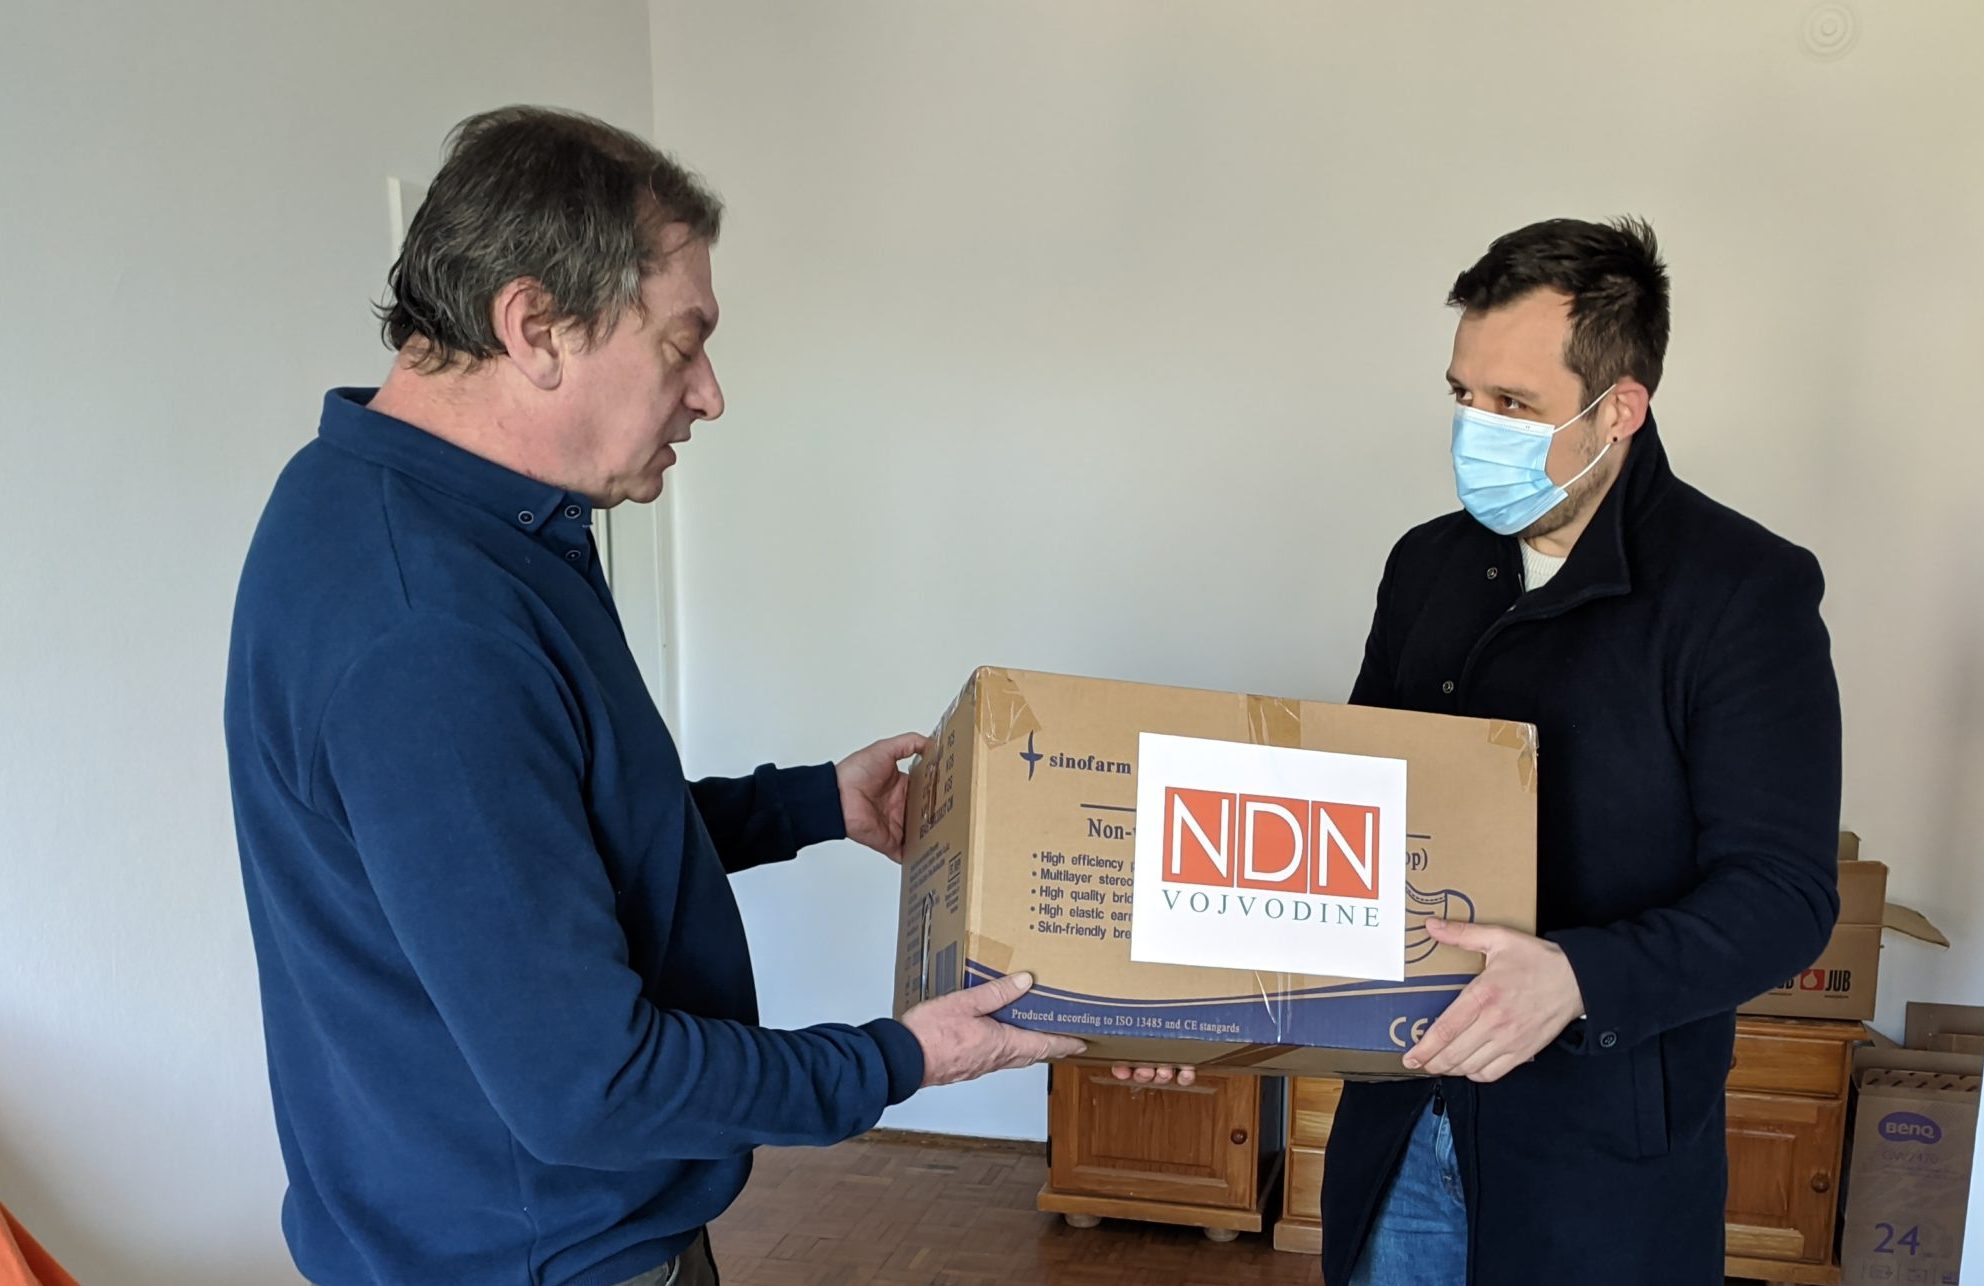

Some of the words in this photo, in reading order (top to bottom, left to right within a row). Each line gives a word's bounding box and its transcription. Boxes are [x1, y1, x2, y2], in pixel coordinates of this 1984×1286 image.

[1049, 753, 1132, 775] sinofarm
[1087, 818, 1136, 840] Non-
[1171, 793, 1374, 891] NDN
[1041, 851, 1065, 866] High
[1071, 854, 1124, 872] efficiency
[1040, 868, 1092, 885] Multilayer
[1040, 885, 1064, 901] High
[1070, 889, 1106, 904] quality
[1039, 903, 1063, 919] High
[1069, 906, 1104, 920] elastic
[1161, 889, 1380, 928] VOJVODINE
[1038, 921, 1106, 940] Skin-friendly
[1825, 969, 1851, 992] JUB
[1012, 1008, 1054, 1021] Produced
[1057, 1012, 1101, 1027] according
[1103, 1016, 1113, 1026] to
[1115, 1015, 1133, 1027] ISO
[1136, 1016, 1162, 1029] 13485
[1165, 1019, 1181, 1030] and
[1184, 1019, 1198, 1031] CE
[1885, 1122, 1936, 1139] BenQ
[1873, 1221, 1921, 1256] 24
